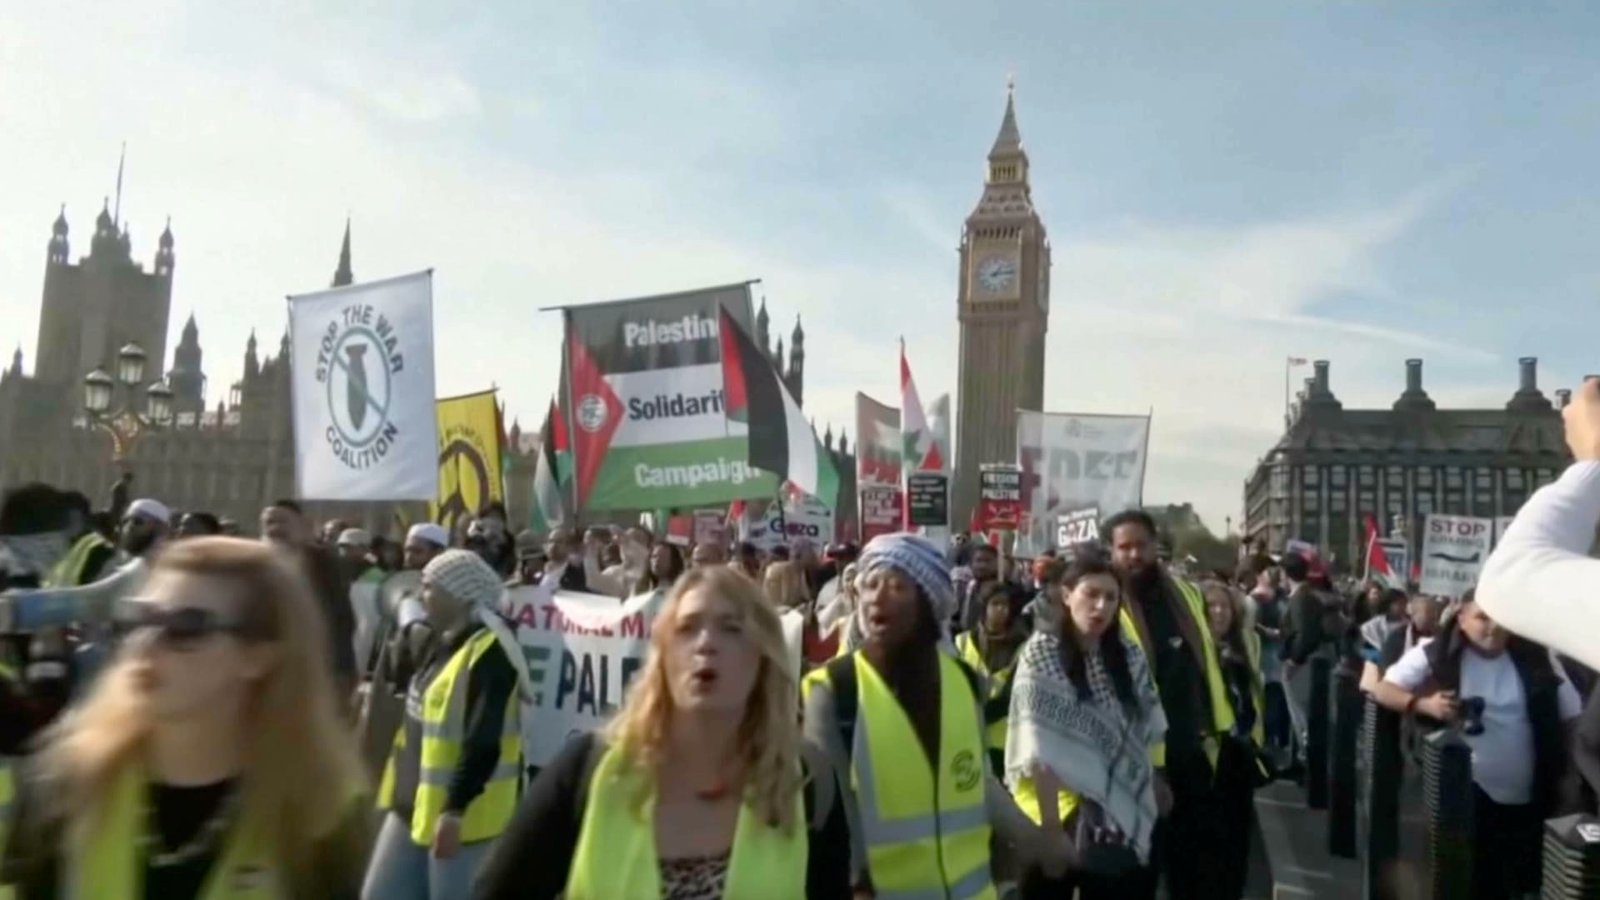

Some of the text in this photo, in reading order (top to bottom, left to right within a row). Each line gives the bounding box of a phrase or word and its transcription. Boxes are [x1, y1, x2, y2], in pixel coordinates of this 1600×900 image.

[315, 304, 404, 383] STOP THE WAR
[624, 314, 716, 347] Palestin
[325, 421, 399, 470] COALITION
[1058, 518, 1099, 547] GAZA
[1431, 521, 1486, 537] STOP
